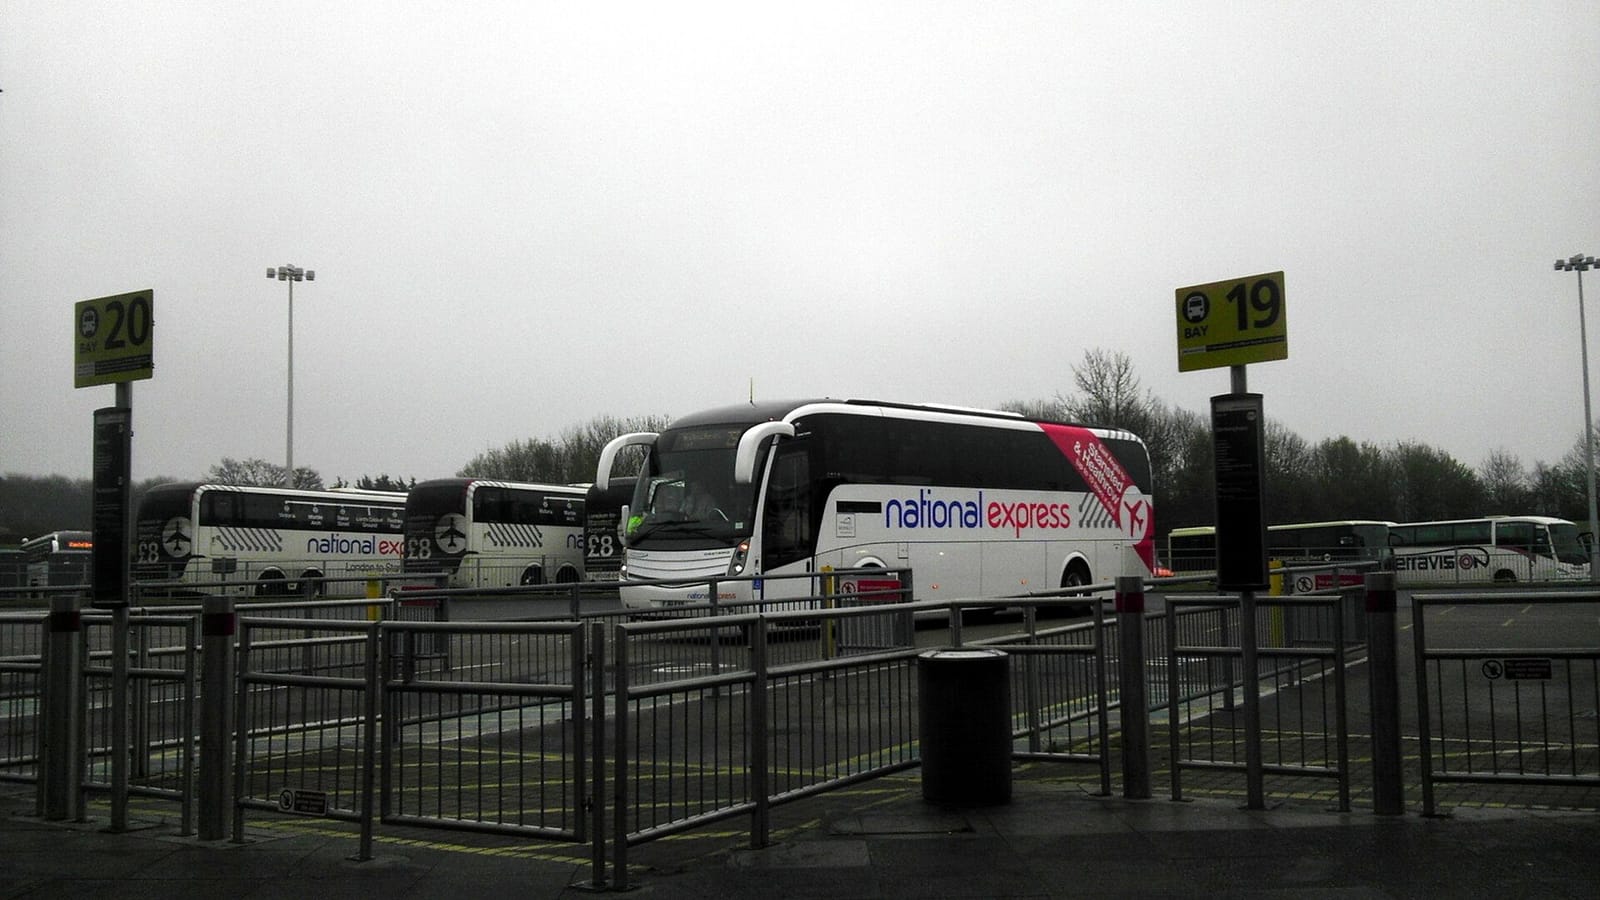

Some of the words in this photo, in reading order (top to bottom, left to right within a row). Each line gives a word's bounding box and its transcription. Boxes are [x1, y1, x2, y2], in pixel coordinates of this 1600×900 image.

[104, 297, 150, 350] 20
[1226, 279, 1281, 331] 19
[1184, 325, 1209, 339] BAY
[1074, 441, 1081, 456] &
[1082, 449, 1120, 504] Heathrow
[1088, 442, 1124, 493] Stansted
[886, 489, 982, 528] national
[987, 502, 1071, 539] express
[307, 533, 376, 554] national
[408, 537, 432, 560] £8
[588, 535, 614, 558] £8
